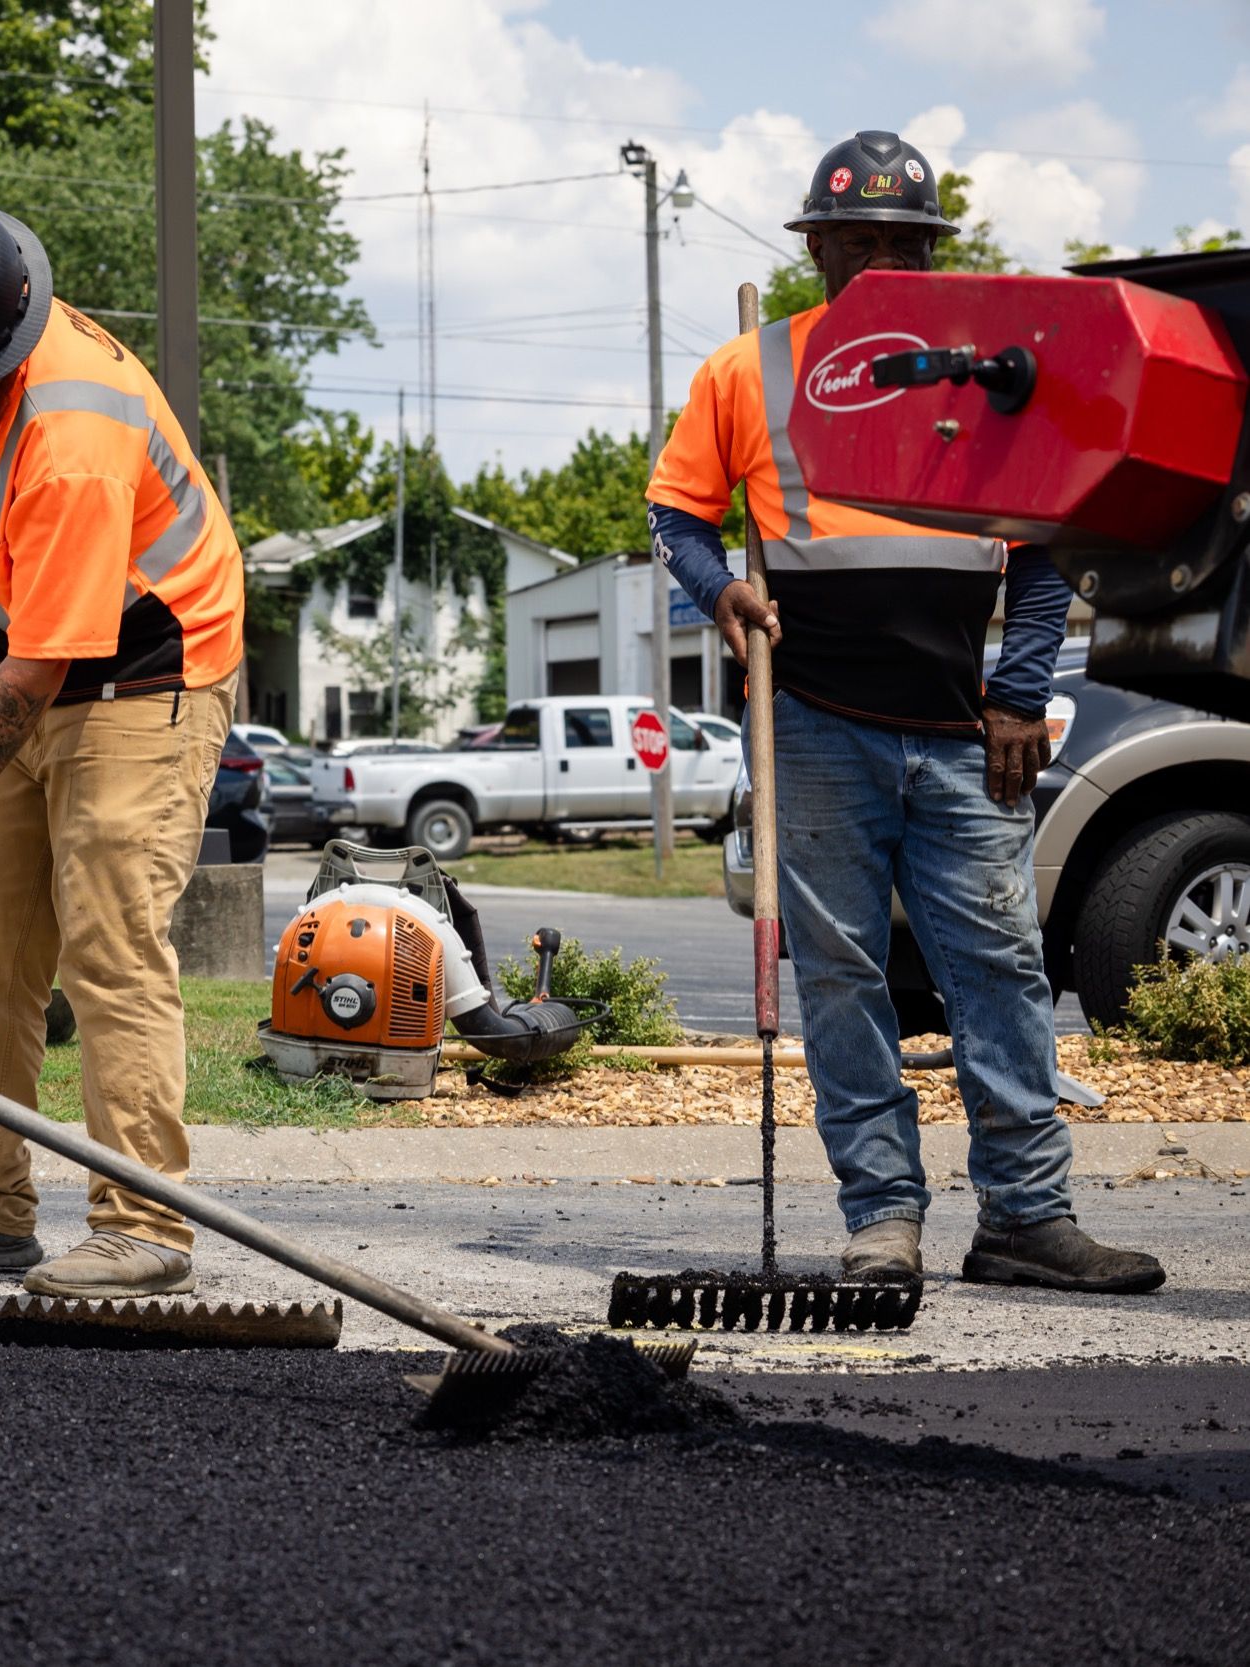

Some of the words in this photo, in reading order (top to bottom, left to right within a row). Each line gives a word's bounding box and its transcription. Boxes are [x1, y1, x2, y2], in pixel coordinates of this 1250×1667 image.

[868, 174, 892, 188] PRI
[634, 727, 666, 755] STOP
[333, 996, 359, 1005] STIHL
[327, 1056, 370, 1069] STIHL
